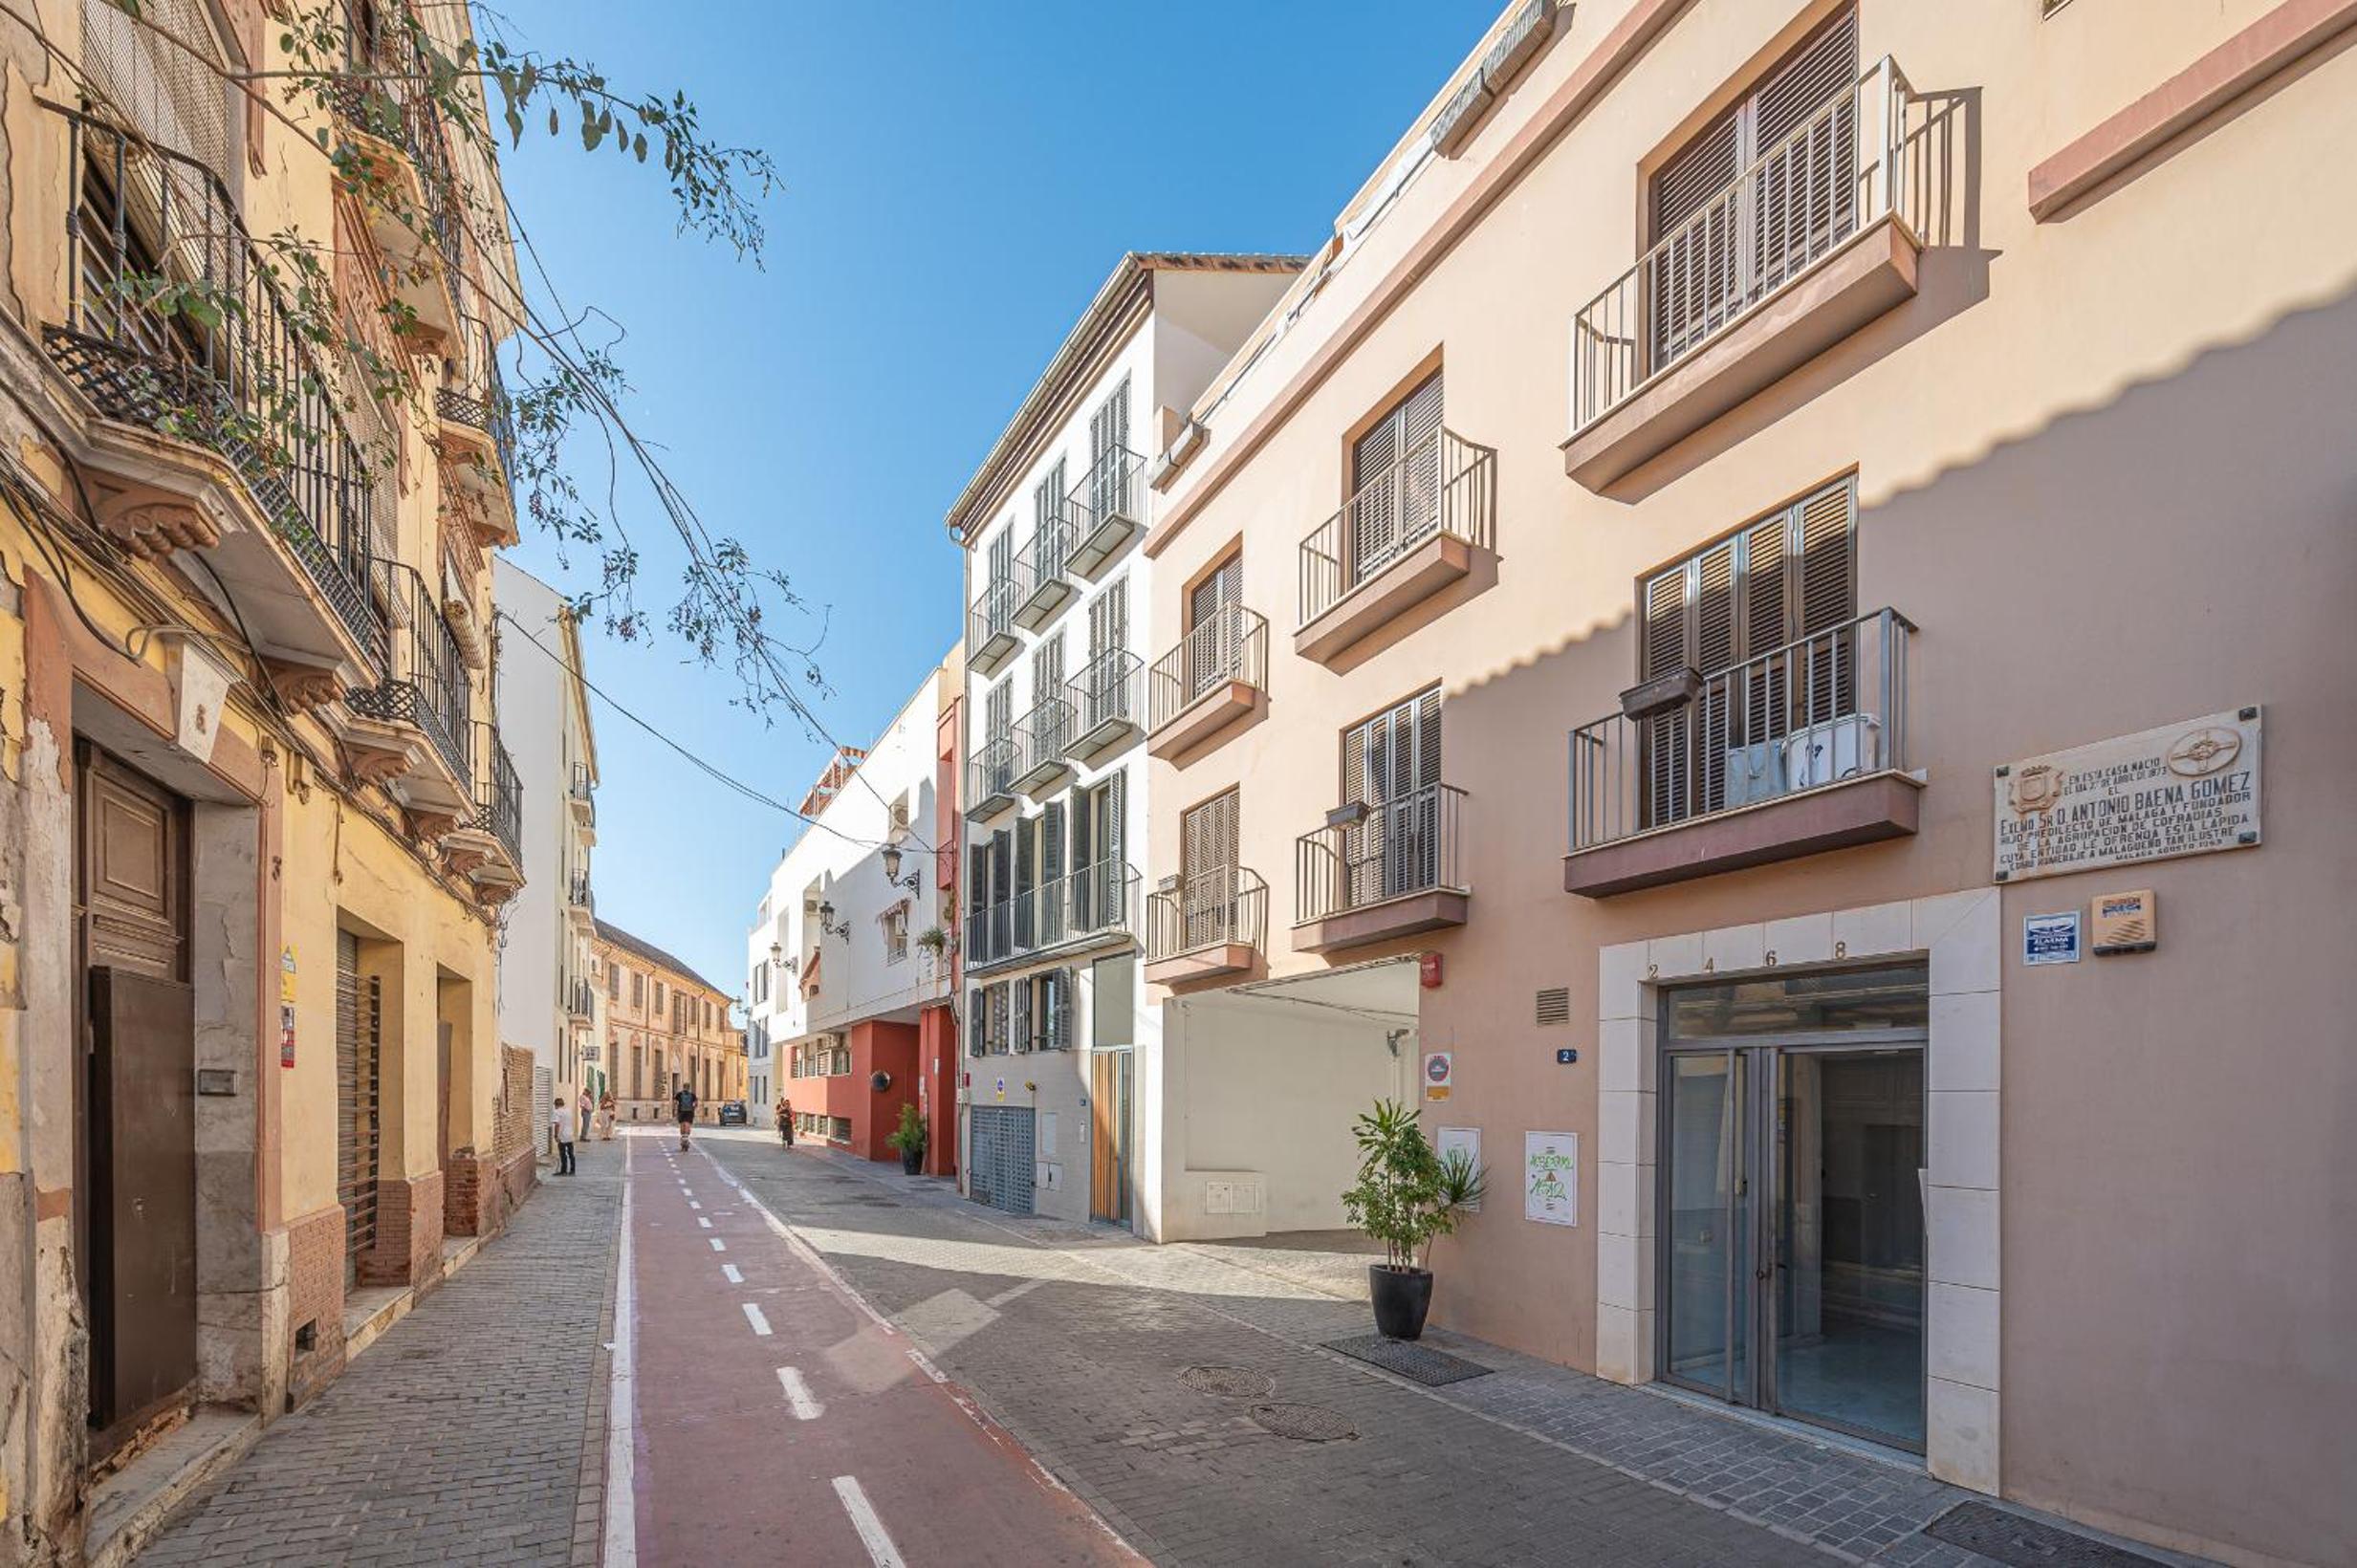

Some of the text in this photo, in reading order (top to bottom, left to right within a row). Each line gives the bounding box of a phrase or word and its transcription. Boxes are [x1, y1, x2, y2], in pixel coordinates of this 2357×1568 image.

[2106, 764, 2128, 776] CASA
[2131, 757, 2160, 772] NACIO
[2072, 795, 2129, 822] ANTONIO
[2135, 785, 2184, 811] BAENA
[2191, 772, 2250, 800] GOMEZ
[2108, 786, 2121, 795] EL
[2026, 820, 2093, 840] PREDILECTO
[2099, 817, 2112, 827] DE
[2118, 807, 2167, 822] MALAGA
[2184, 792, 2251, 811] FUNDADOR
[2058, 825, 2128, 844] AGRUPACION
[2132, 820, 2147, 832] DE
[2152, 807, 2222, 827] COFRADIAS
[2031, 843, 2076, 859] ENTIDAD
[2084, 838, 2096, 849] LE
[2104, 829, 2159, 846] OFRENDA
[2165, 823, 2194, 837] ESTA
[2201, 814, 2249, 830] LAPIDA
[2158, 843, 2193, 854] AGOSTO
[2166, 834, 2185, 845] TAN
[2189, 826, 2235, 842] ILUSTRE
[1648, 941, 1846, 979] 2 4 6 8
